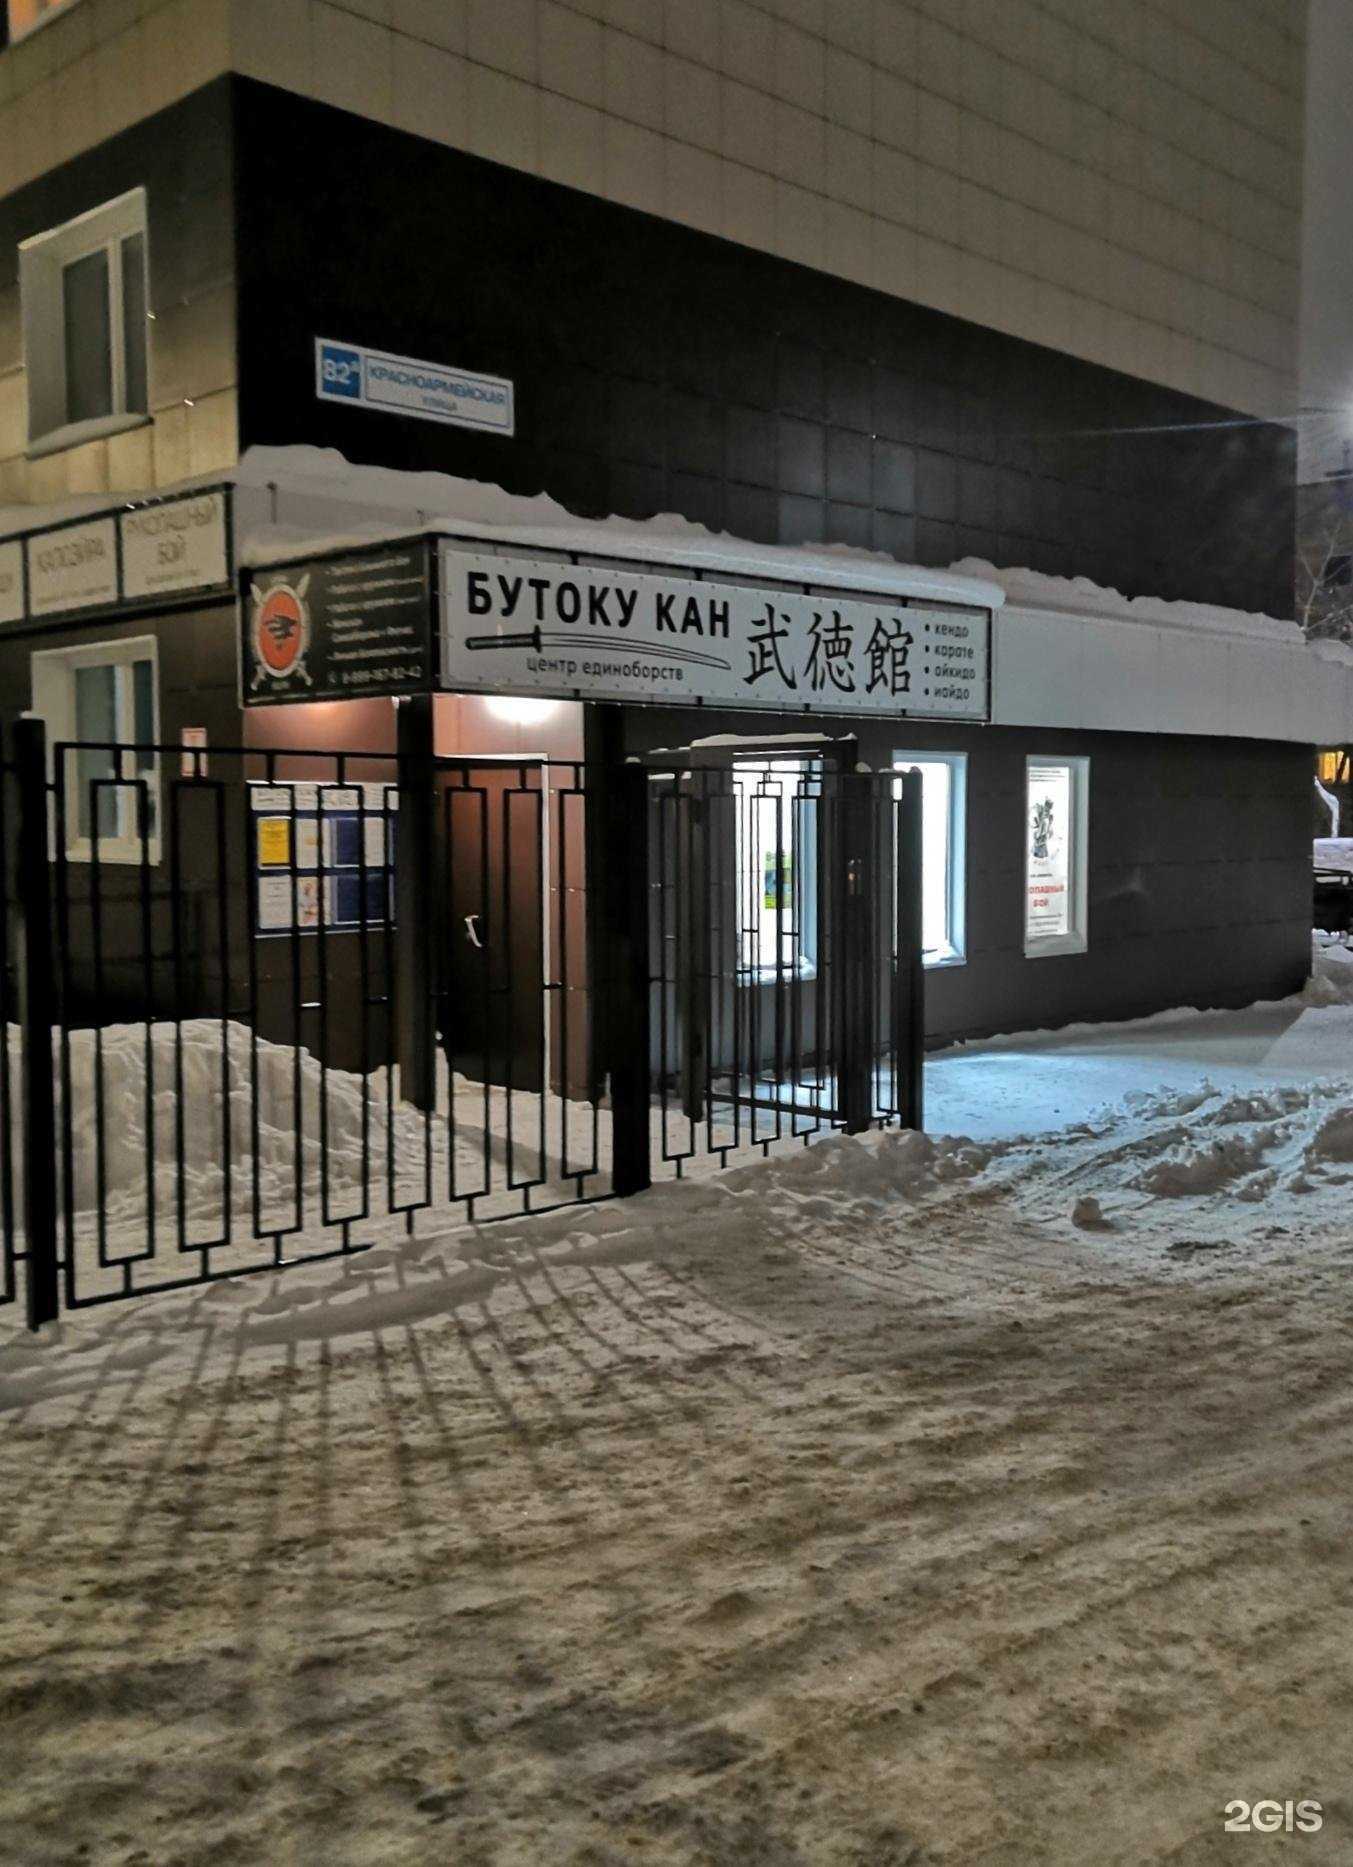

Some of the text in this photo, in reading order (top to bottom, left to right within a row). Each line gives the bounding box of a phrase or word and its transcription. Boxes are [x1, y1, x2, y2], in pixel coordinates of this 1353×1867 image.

[467, 571, 729, 638] БУТОКУ КАН
[935, 624, 969, 638] кендо
[934, 645, 974, 659] карате
[527, 657, 683, 682] центр единоборств
[935, 663, 976, 680] айкидо
